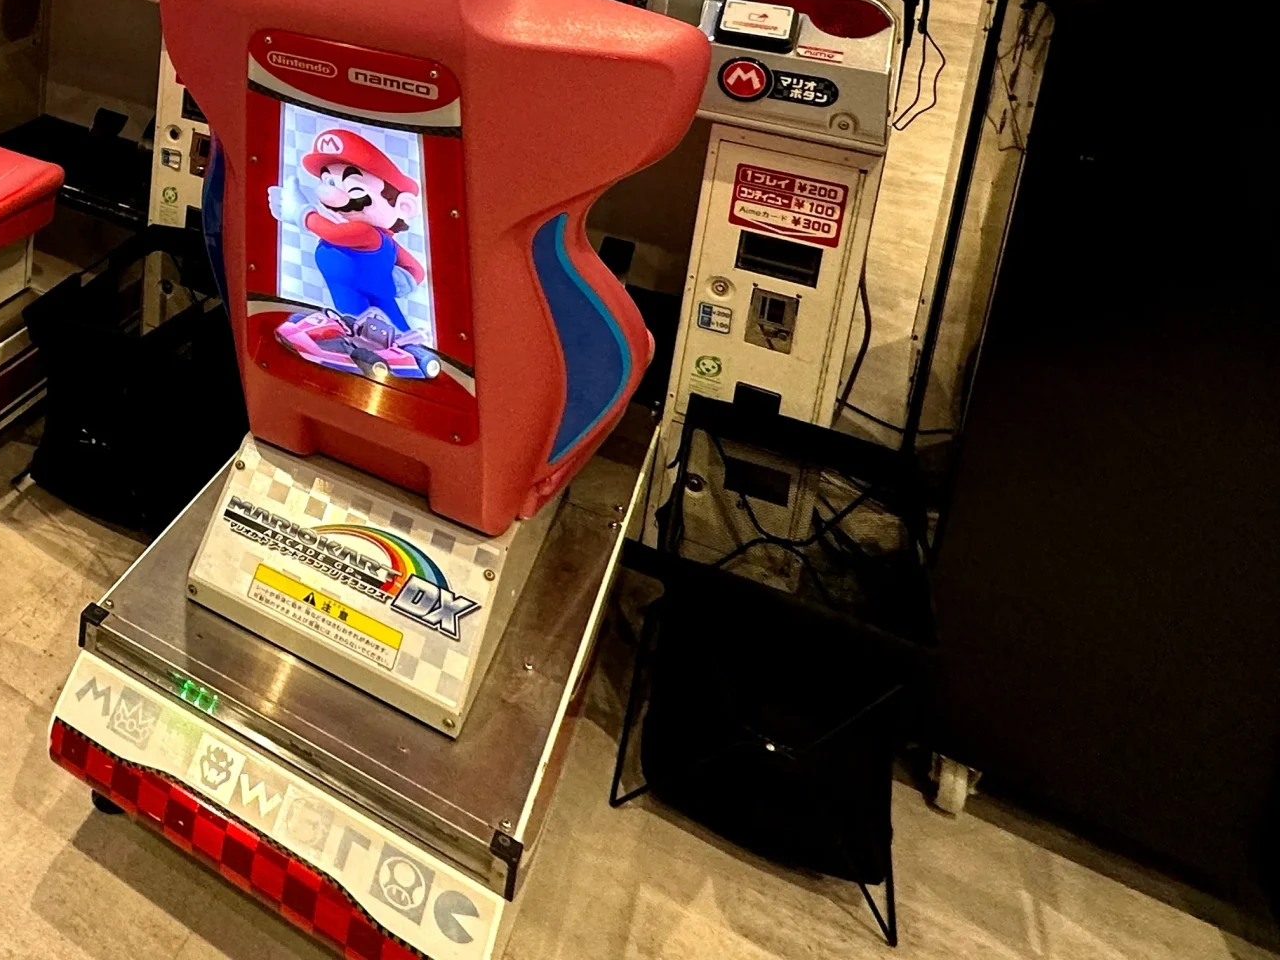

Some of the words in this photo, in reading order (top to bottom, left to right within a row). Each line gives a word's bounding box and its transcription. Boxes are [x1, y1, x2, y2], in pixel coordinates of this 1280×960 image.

[271, 53, 332, 75] Nintendo
[353, 70, 431, 96] namco
[726, 66, 761, 90] M
[780, 75, 817, 91] マリオ
[789, 88, 828, 103] ボタン
[739, 187, 790, 206] コンティニュー
[794, 198, 836, 218] ¥100
[797, 181, 838, 199] ¥200
[791, 215, 832, 234] ¥300
[227, 495, 318, 546] MARIO
[320, 534, 403, 582] KART
[263, 528, 327, 562] ARCADE
[391, 573, 483, 642] DX
